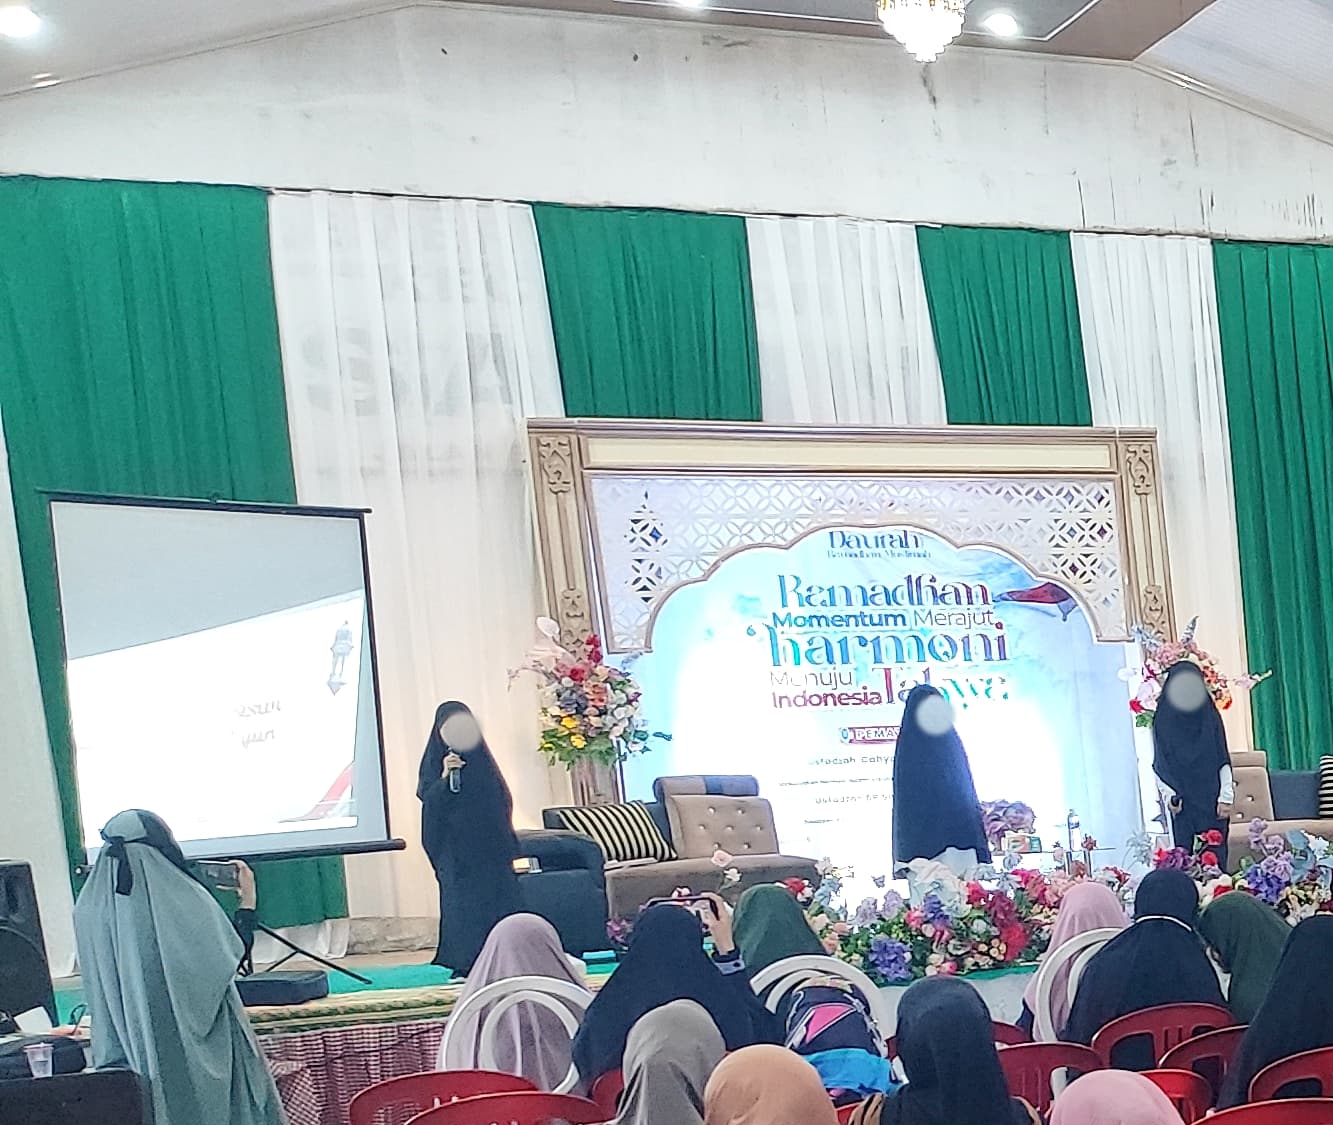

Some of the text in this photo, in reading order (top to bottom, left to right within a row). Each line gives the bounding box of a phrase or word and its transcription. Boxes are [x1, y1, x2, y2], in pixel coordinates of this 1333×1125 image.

[828, 529, 922, 549] Daurah
[777, 573, 995, 609] Ramadhan
[772, 609, 996, 630] Momentum Merajut
[771, 685, 883, 710] Indonesia
